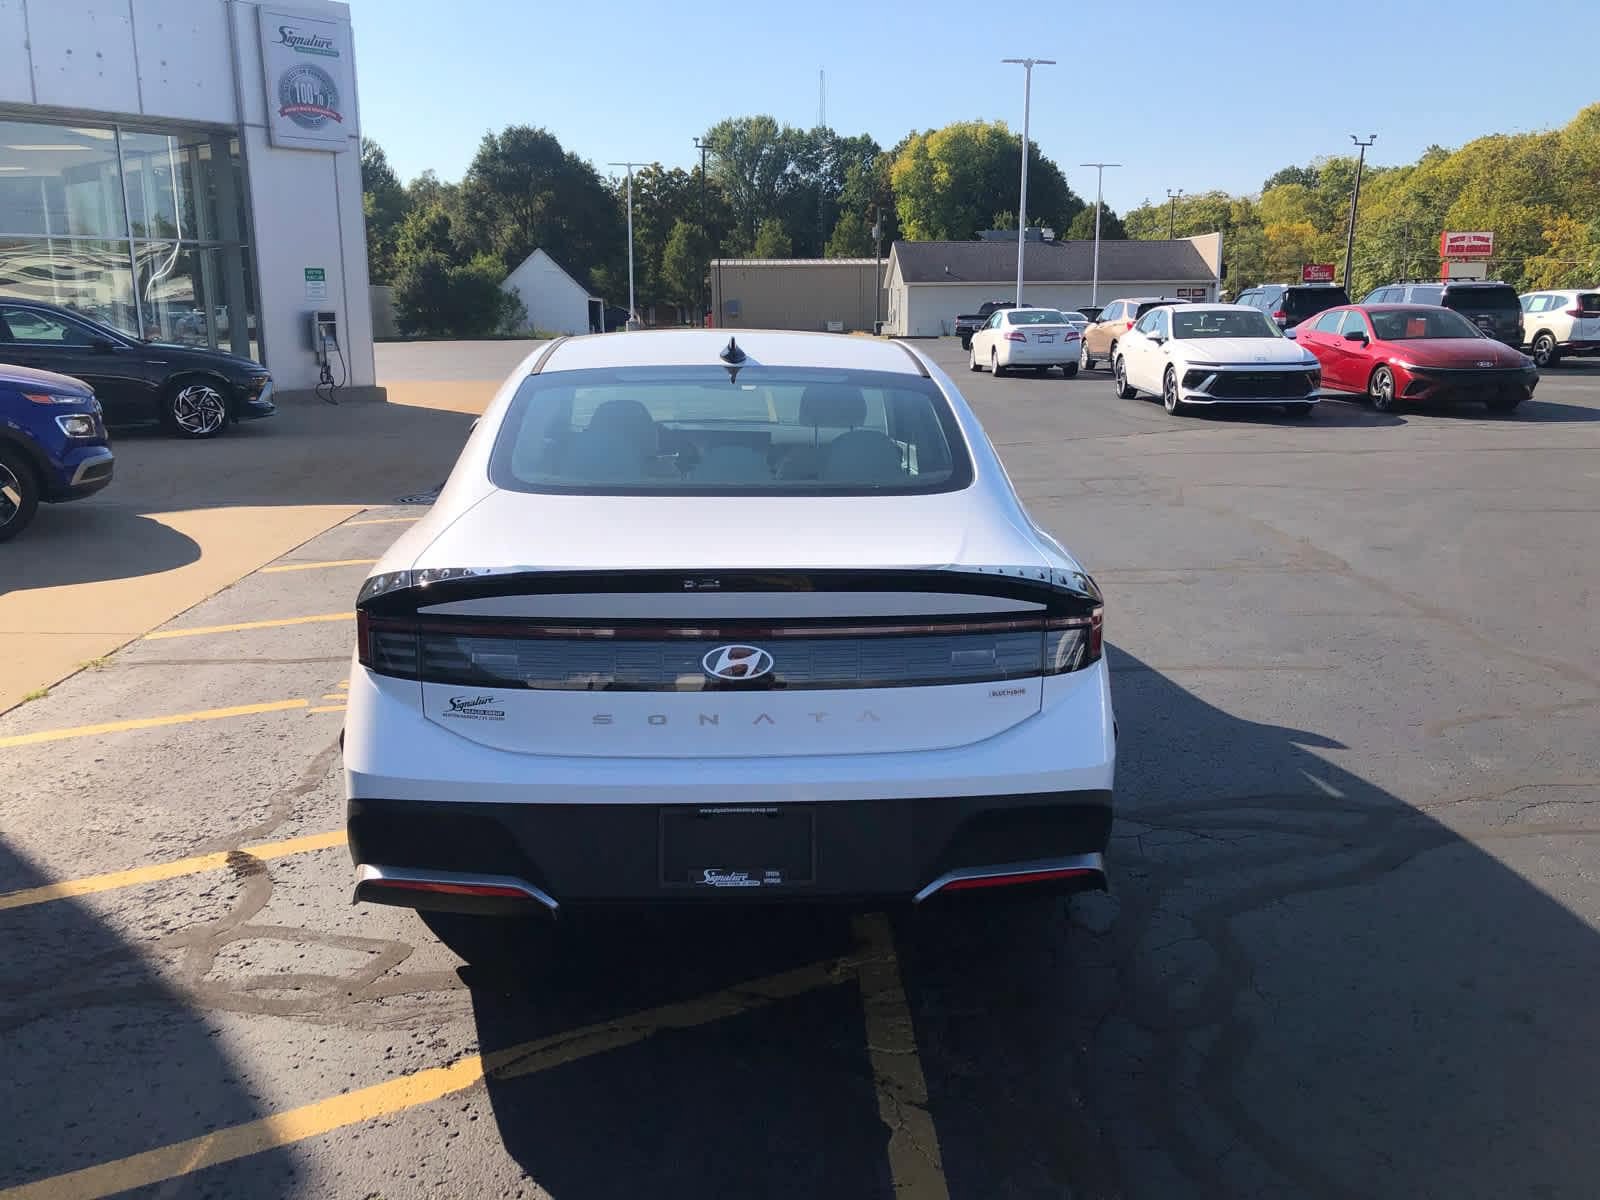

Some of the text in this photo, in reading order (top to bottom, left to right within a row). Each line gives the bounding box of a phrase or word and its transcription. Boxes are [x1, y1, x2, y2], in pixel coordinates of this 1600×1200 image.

[278, 26, 333, 49] Signature
[294, 82, 324, 105] 100%
[449, 696, 495, 712] Signature
[592, 709, 880, 726] SONATA
[703, 868, 749, 885] Signature
